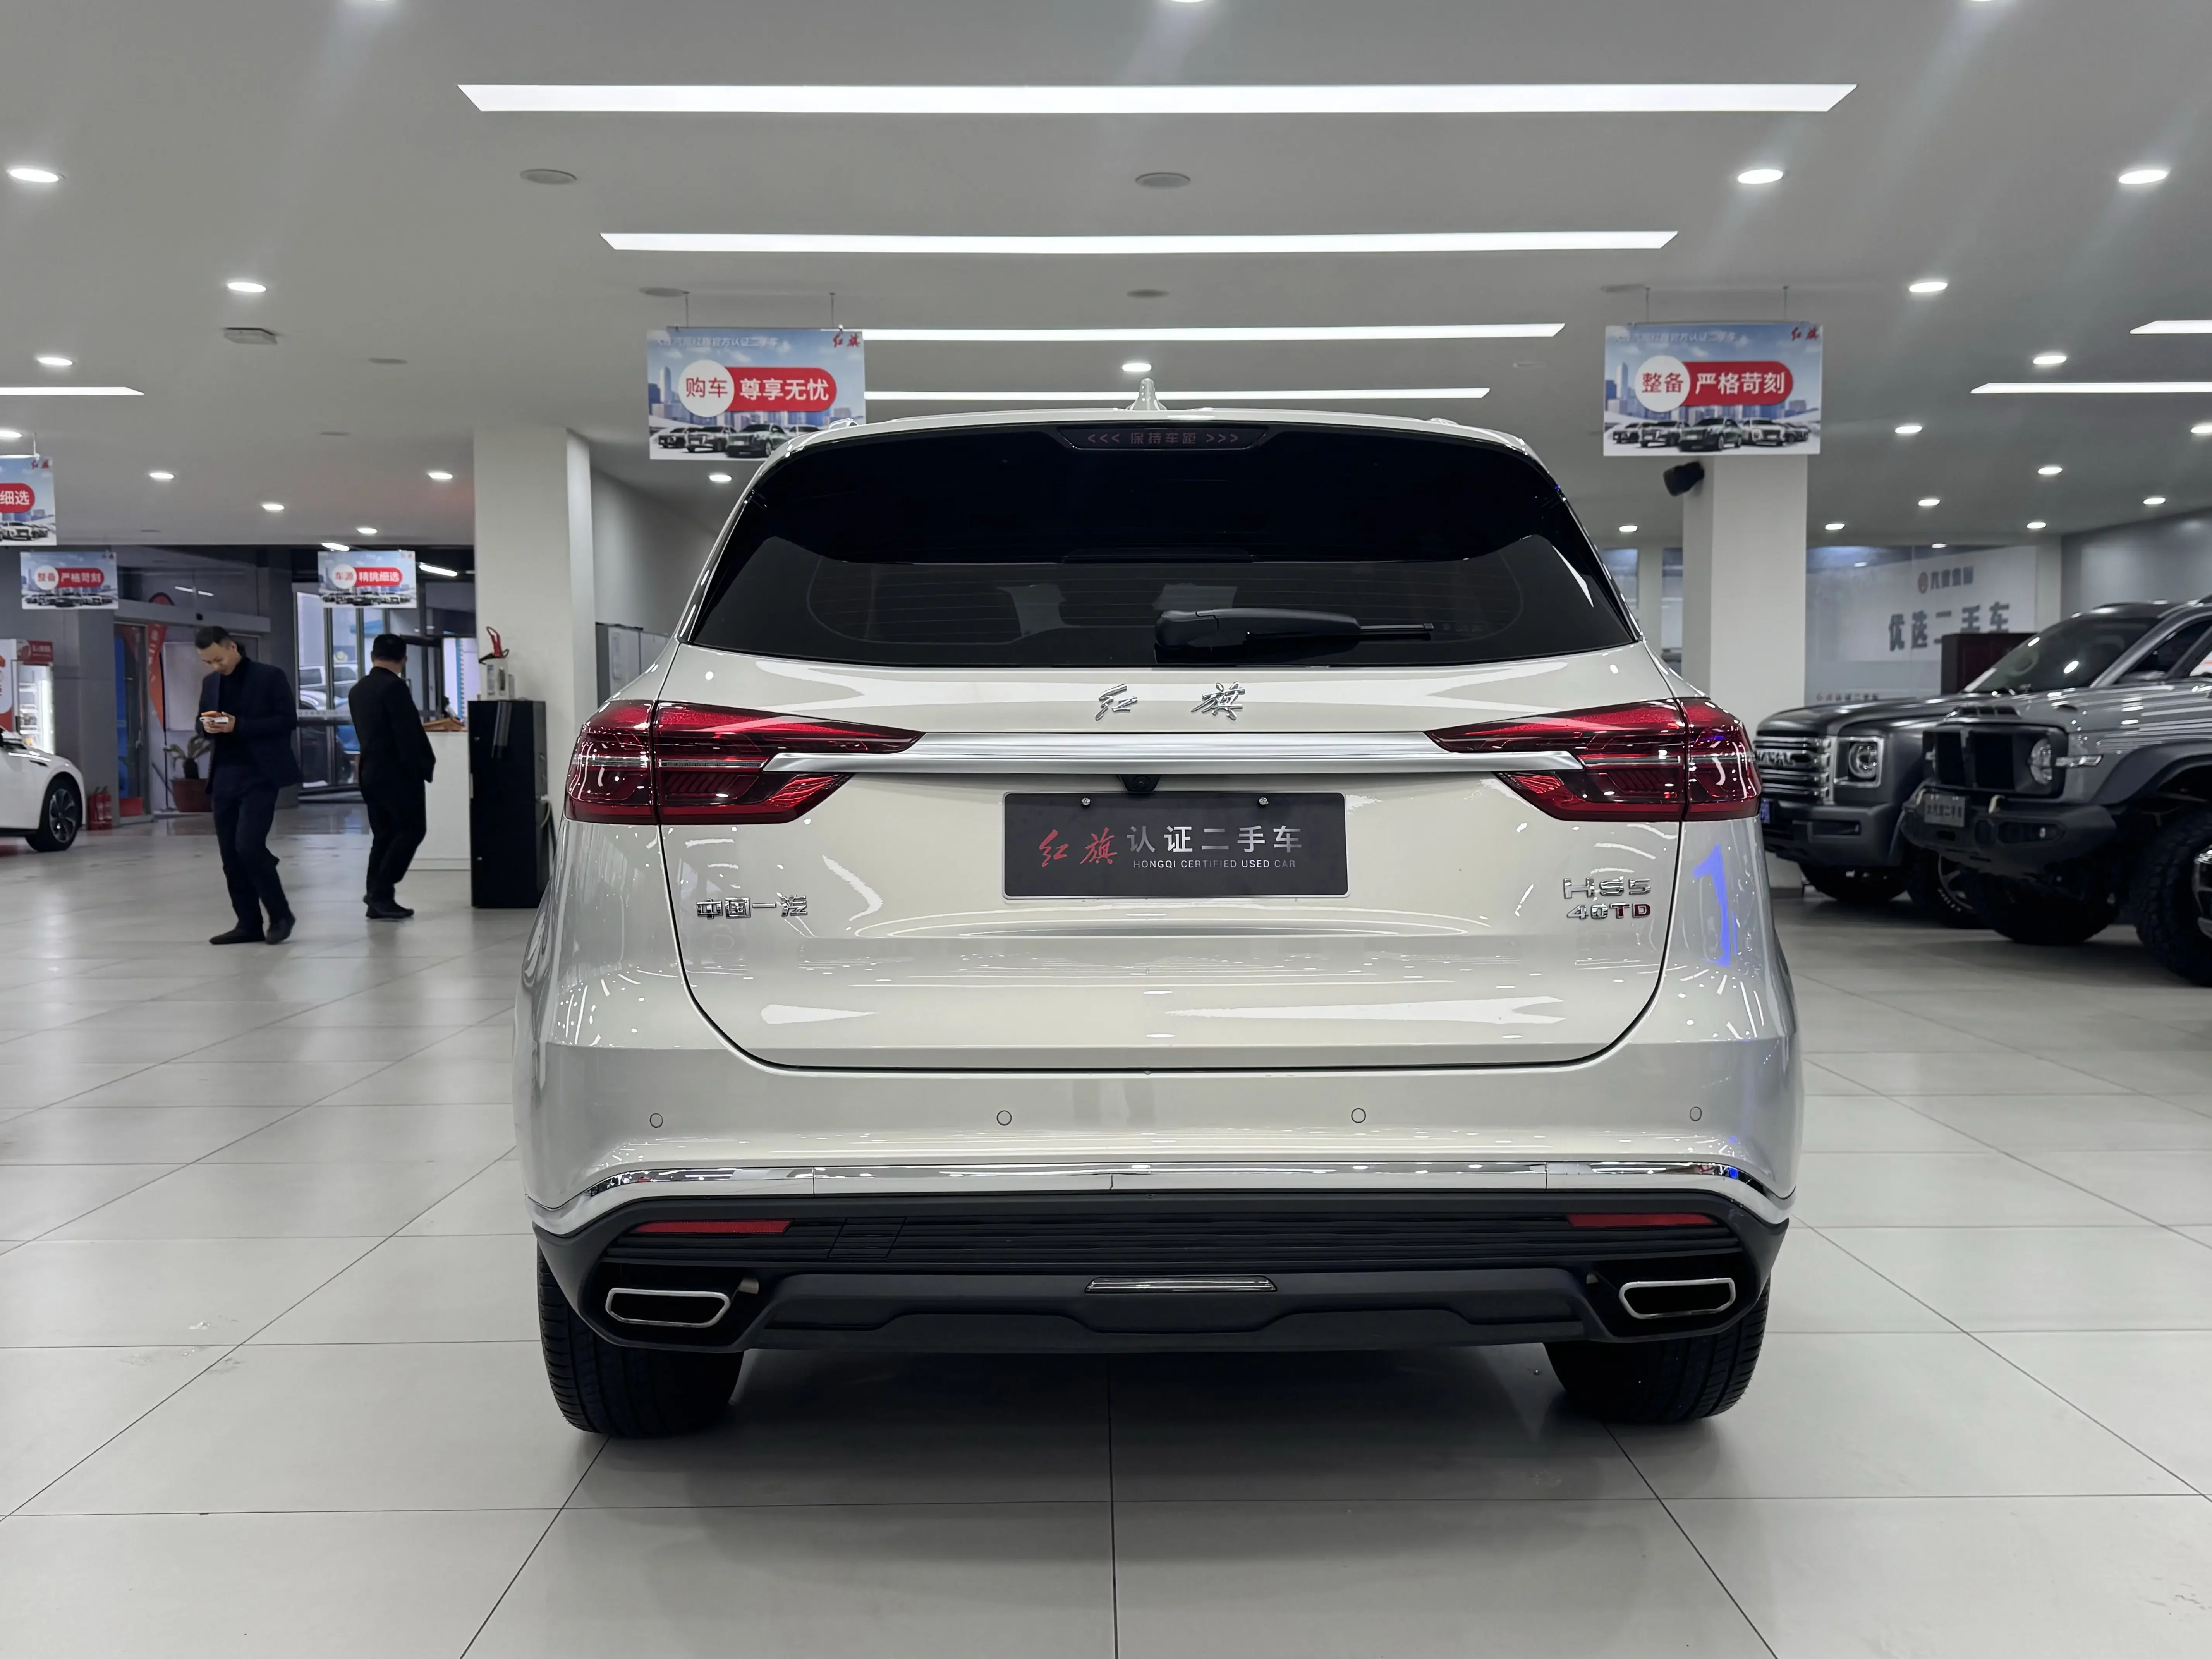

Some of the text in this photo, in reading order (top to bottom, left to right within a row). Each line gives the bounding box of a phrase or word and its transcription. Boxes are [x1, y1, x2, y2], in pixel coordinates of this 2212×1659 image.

[686, 377, 829, 400] 购车 尊享无忧
[1642, 372, 1785, 395] 整备 严格苛刻
[1130, 432, 1196, 444] 保持车距
[0, 490, 30, 505] 细选
[1095, 681, 1245, 721] 红旗
[1039, 825, 1302, 867] 红旗 认证二手车
[1133, 860, 1176, 868] HONGQI
[1563, 877, 1651, 899] HS5
[696, 892, 808, 919] 中国一汽
[1566, 902, 1651, 920] 40TD
